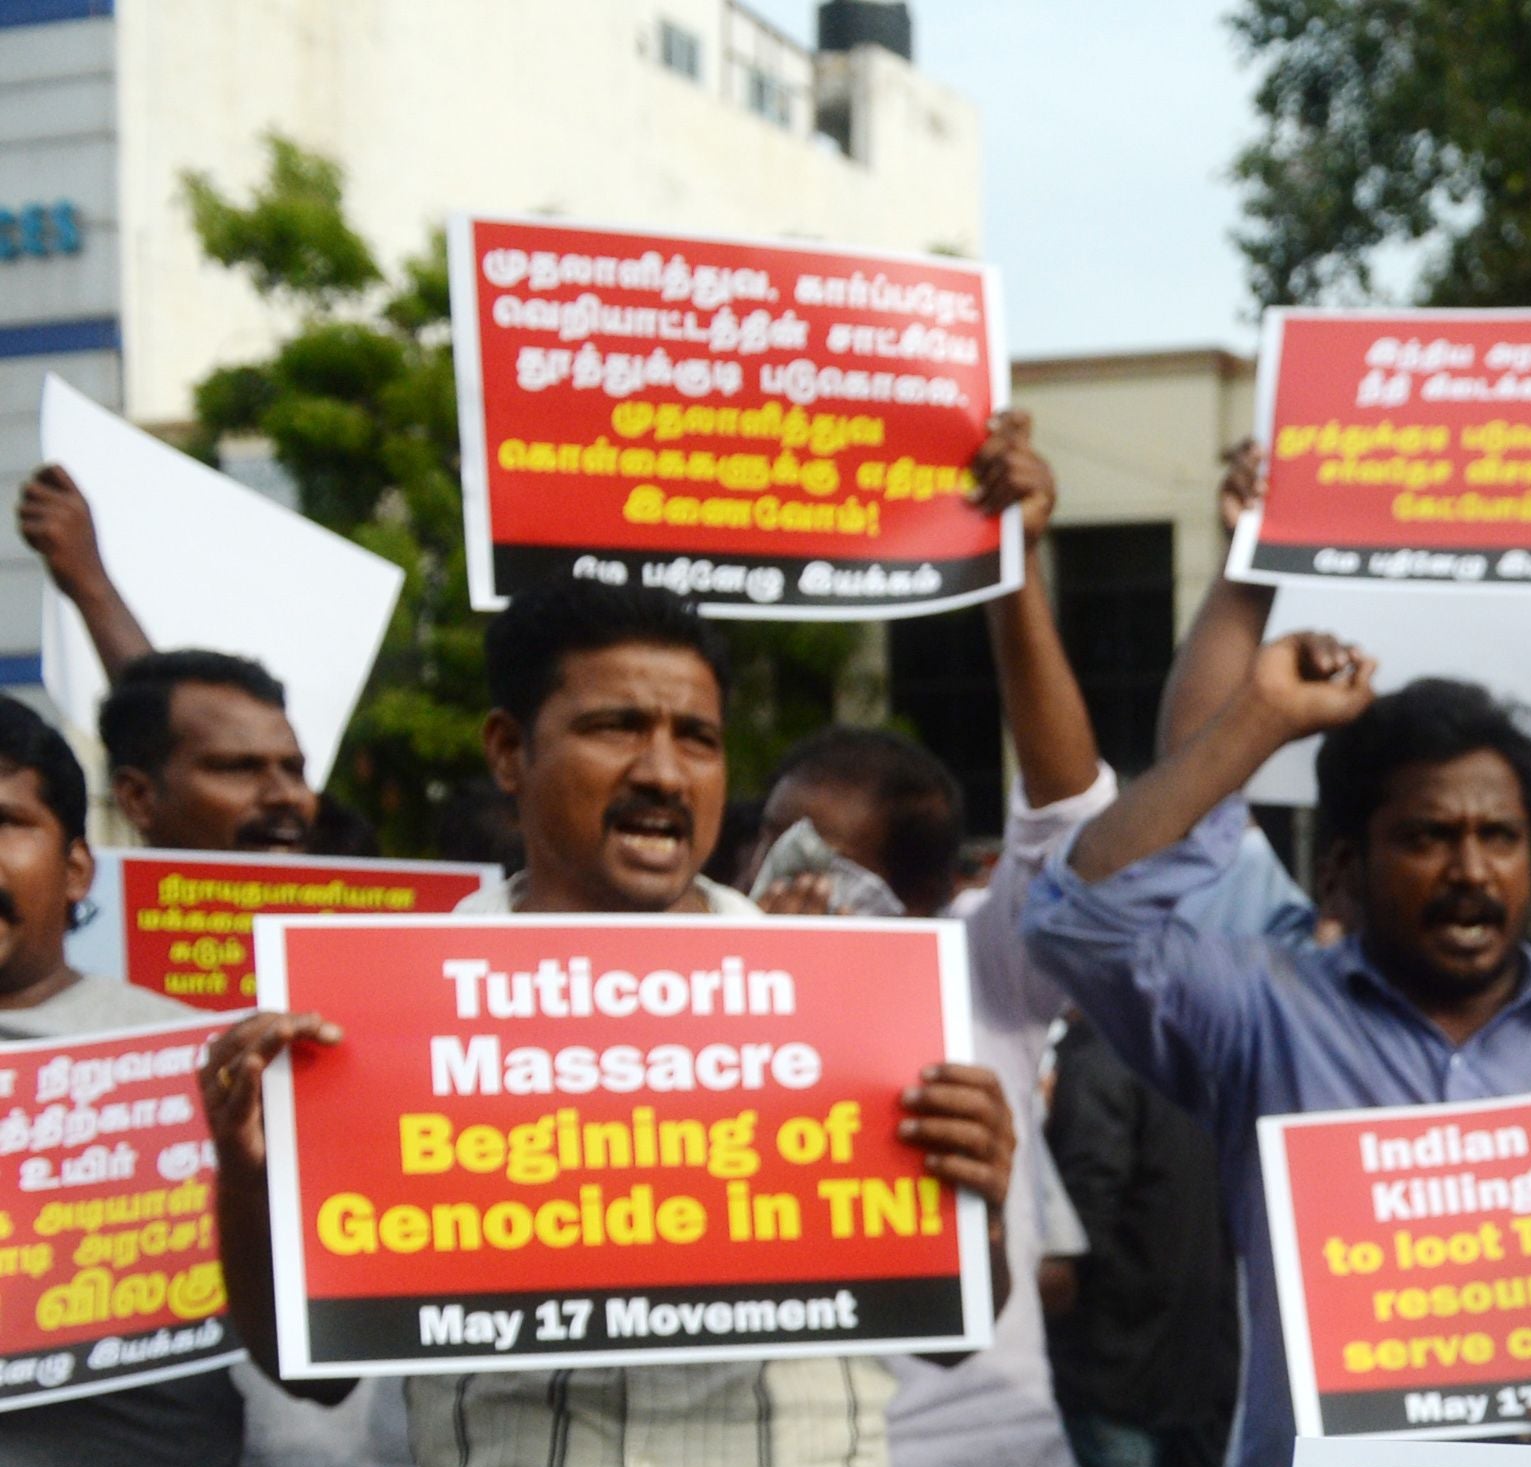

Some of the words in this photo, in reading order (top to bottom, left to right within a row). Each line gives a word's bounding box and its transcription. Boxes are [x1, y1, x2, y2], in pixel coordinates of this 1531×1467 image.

[443, 956, 795, 1019] Tuticorin
[430, 1034, 822, 1097] Massacre
[399, 1106, 760, 1184] Begining
[775, 1102, 861, 1165] of
[1359, 1124, 1529, 1174] Indian
[317, 1184, 707, 1255] Genocide
[726, 1179, 801, 1242] in
[819, 1177, 943, 1238] TN!
[1323, 1236, 1383, 1276] to
[1396, 1220, 1506, 1268] loot
[419, 1304, 523, 1350] May
[535, 1300, 594, 1340] 17
[605, 1290, 859, 1339] Movement
[1343, 1330, 1496, 1375] serve
[1405, 1393, 1488, 1425] May
